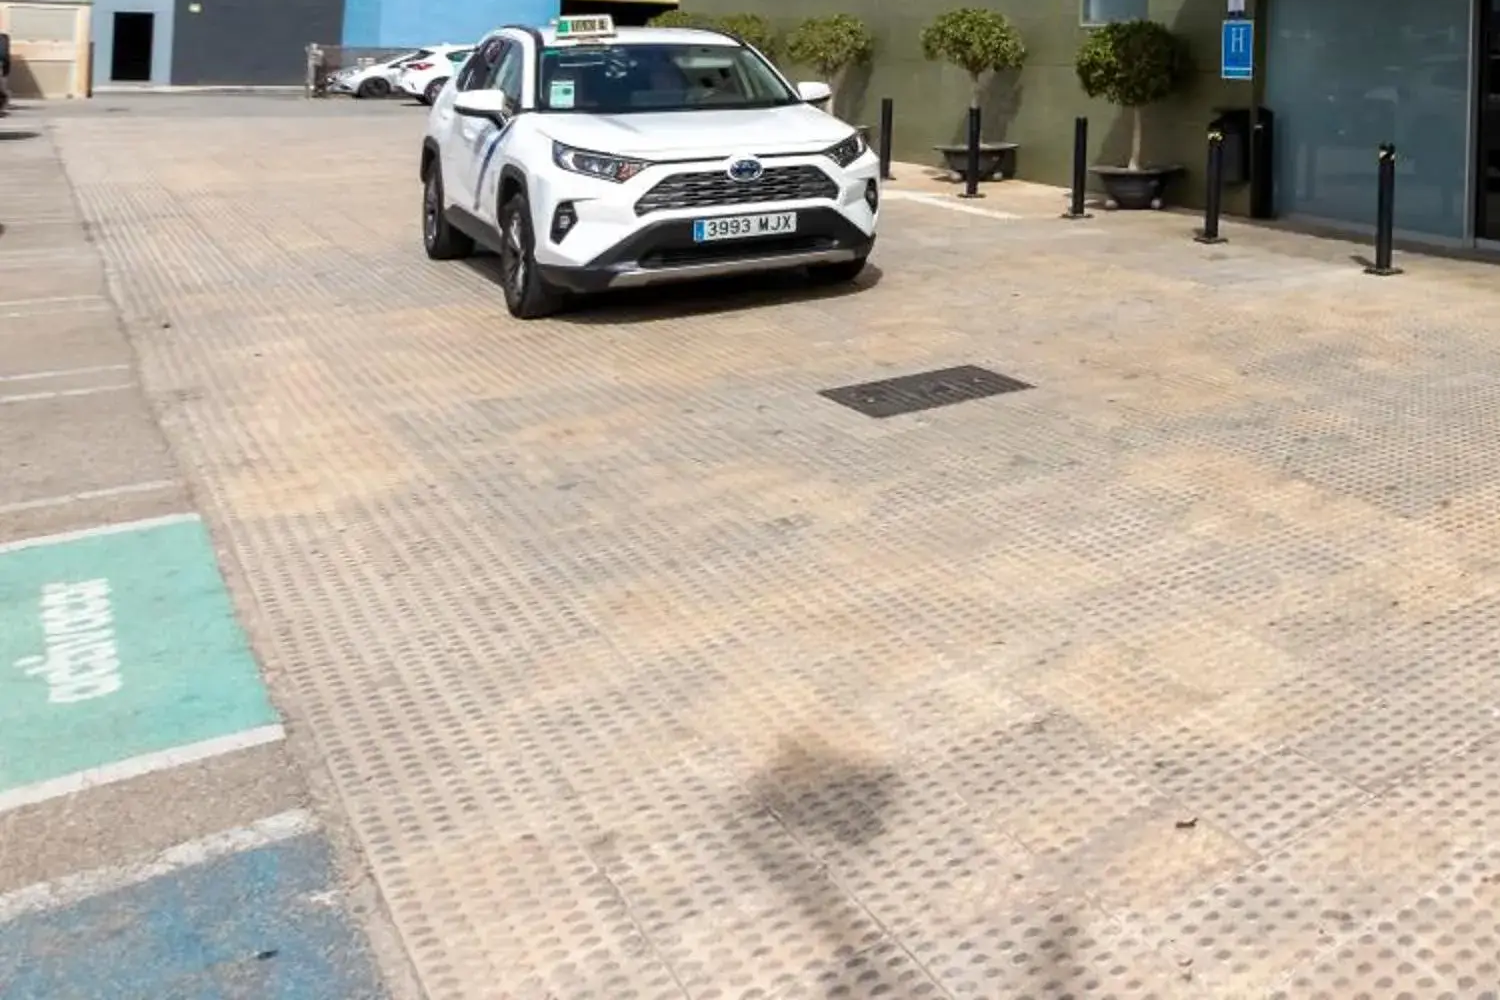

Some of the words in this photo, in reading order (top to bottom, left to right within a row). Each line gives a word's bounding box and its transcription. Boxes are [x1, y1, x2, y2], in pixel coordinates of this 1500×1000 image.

[1231, 27, 1244, 53] H
[708, 218, 751, 237] 3993
[758, 215, 791, 233] MJX
